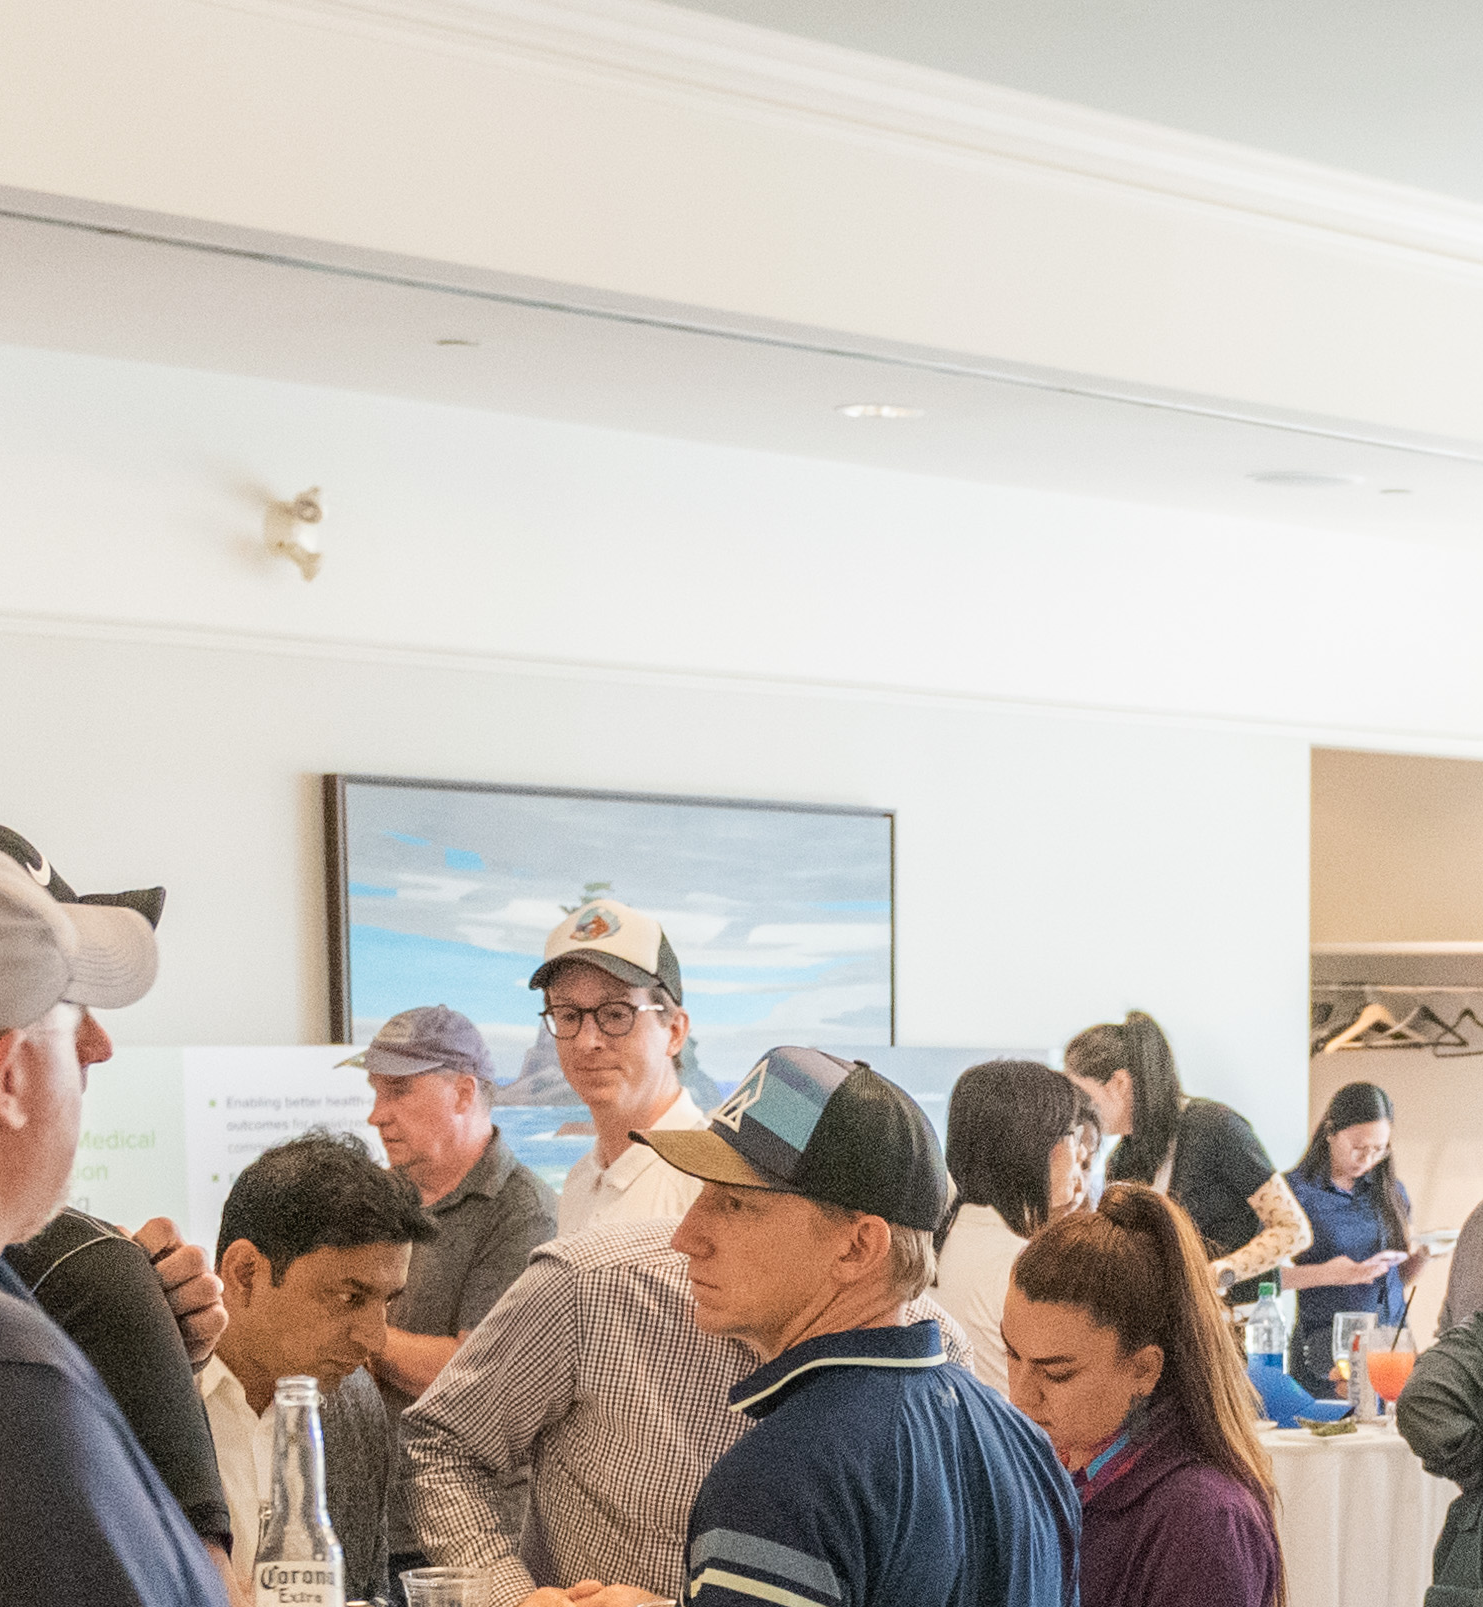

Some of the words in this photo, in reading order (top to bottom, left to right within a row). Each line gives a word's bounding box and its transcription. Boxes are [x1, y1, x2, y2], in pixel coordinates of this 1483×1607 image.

[226, 1096, 282, 1111] Enabling
[285, 1096, 321, 1108] better
[226, 1120, 289, 1132] outcomes
[260, 1565, 336, 1591] Corona
[277, 1588, 323, 1604] Extra
